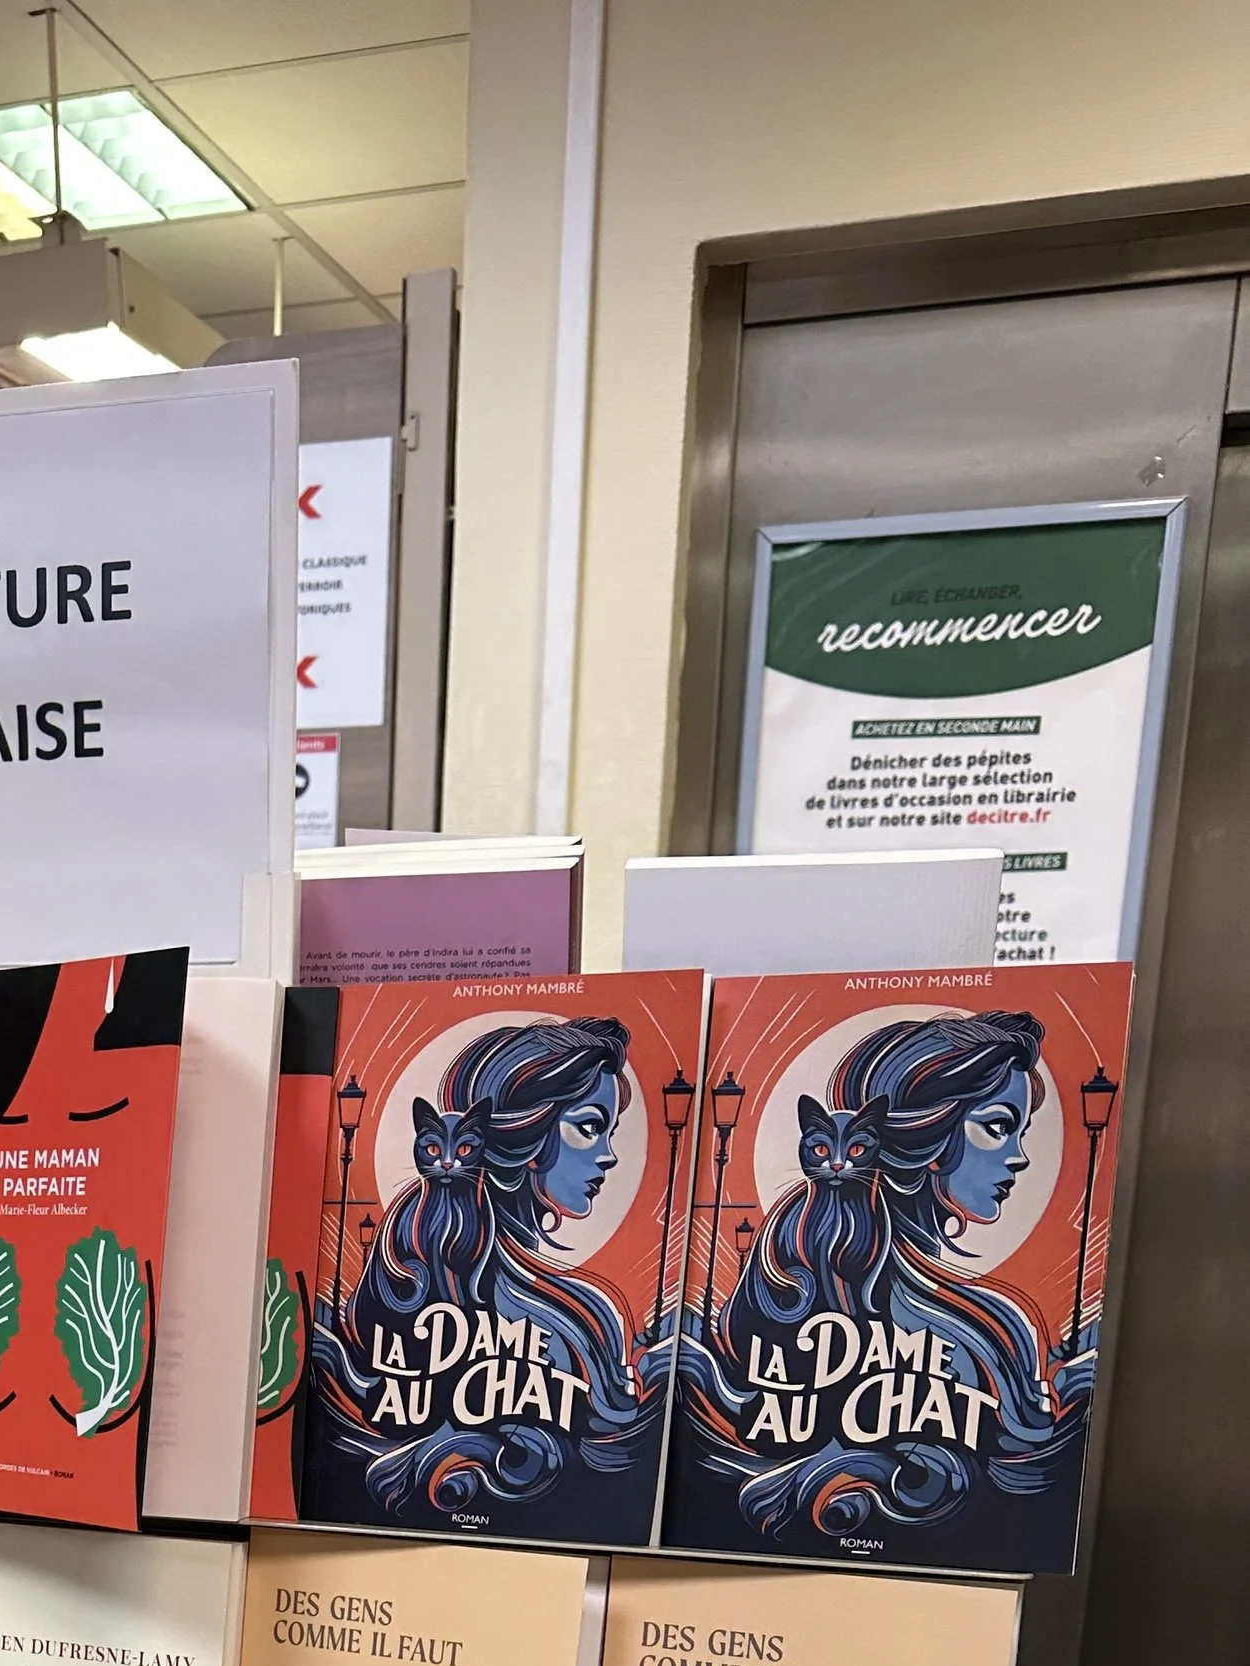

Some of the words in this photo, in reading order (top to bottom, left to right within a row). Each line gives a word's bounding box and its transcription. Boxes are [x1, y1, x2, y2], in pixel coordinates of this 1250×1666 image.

[817, 604, 1102, 653] recommencer
[855, 721, 914, 736] ACHETEZ
[917, 721, 935, 734] EN
[937, 720, 998, 734] SECONDE
[1001, 718, 1037, 733] MAIN
[851, 753, 927, 770] Dénicher
[932, 753, 961, 768] des
[967, 751, 1032, 772] pépites
[827, 774, 866, 791] dans
[871, 775, 916, 789] notre
[922, 772, 968, 791] large
[972, 770, 1053, 786] sélection
[806, 795, 824, 810] de
[830, 794, 878, 809] livres
[884, 792, 971, 807] d'occasion
[977, 792, 998, 804] en
[1003, 788, 1076, 804] librairie
[826, 813, 842, 828] et
[847, 815, 875, 827] sur
[880, 813, 925, 827] notre
[930, 811, 962, 826] site
[967, 808, 1051, 825] decitre.fr
[306, 951, 332, 960] Avant
[336, 950, 347, 959] de
[351, 949, 383, 960] mourir,
[387, 948, 395, 958] le
[398, 948, 421, 960] père
[462, 947, 473, 956] lui
[487, 945, 516, 956] confié
[845, 974, 925, 991] ANTHONY
[929, 970, 993, 989] MAMBRÉ
[34, 1147, 99, 1168] MAMAN
[3, 1177, 86, 1196] PARFAITE
[0, 1204, 50, 1216] Marie-Fleur
[51, 1203, 87, 1215] Albecker
[747, 1393, 817, 1443] AU
[841, 1373, 999, 1450] CHAT
[840, 1537, 883, 1551] ROMAN
[642, 1622, 695, 1653] DES
[707, 1628, 784, 1663] GENS
